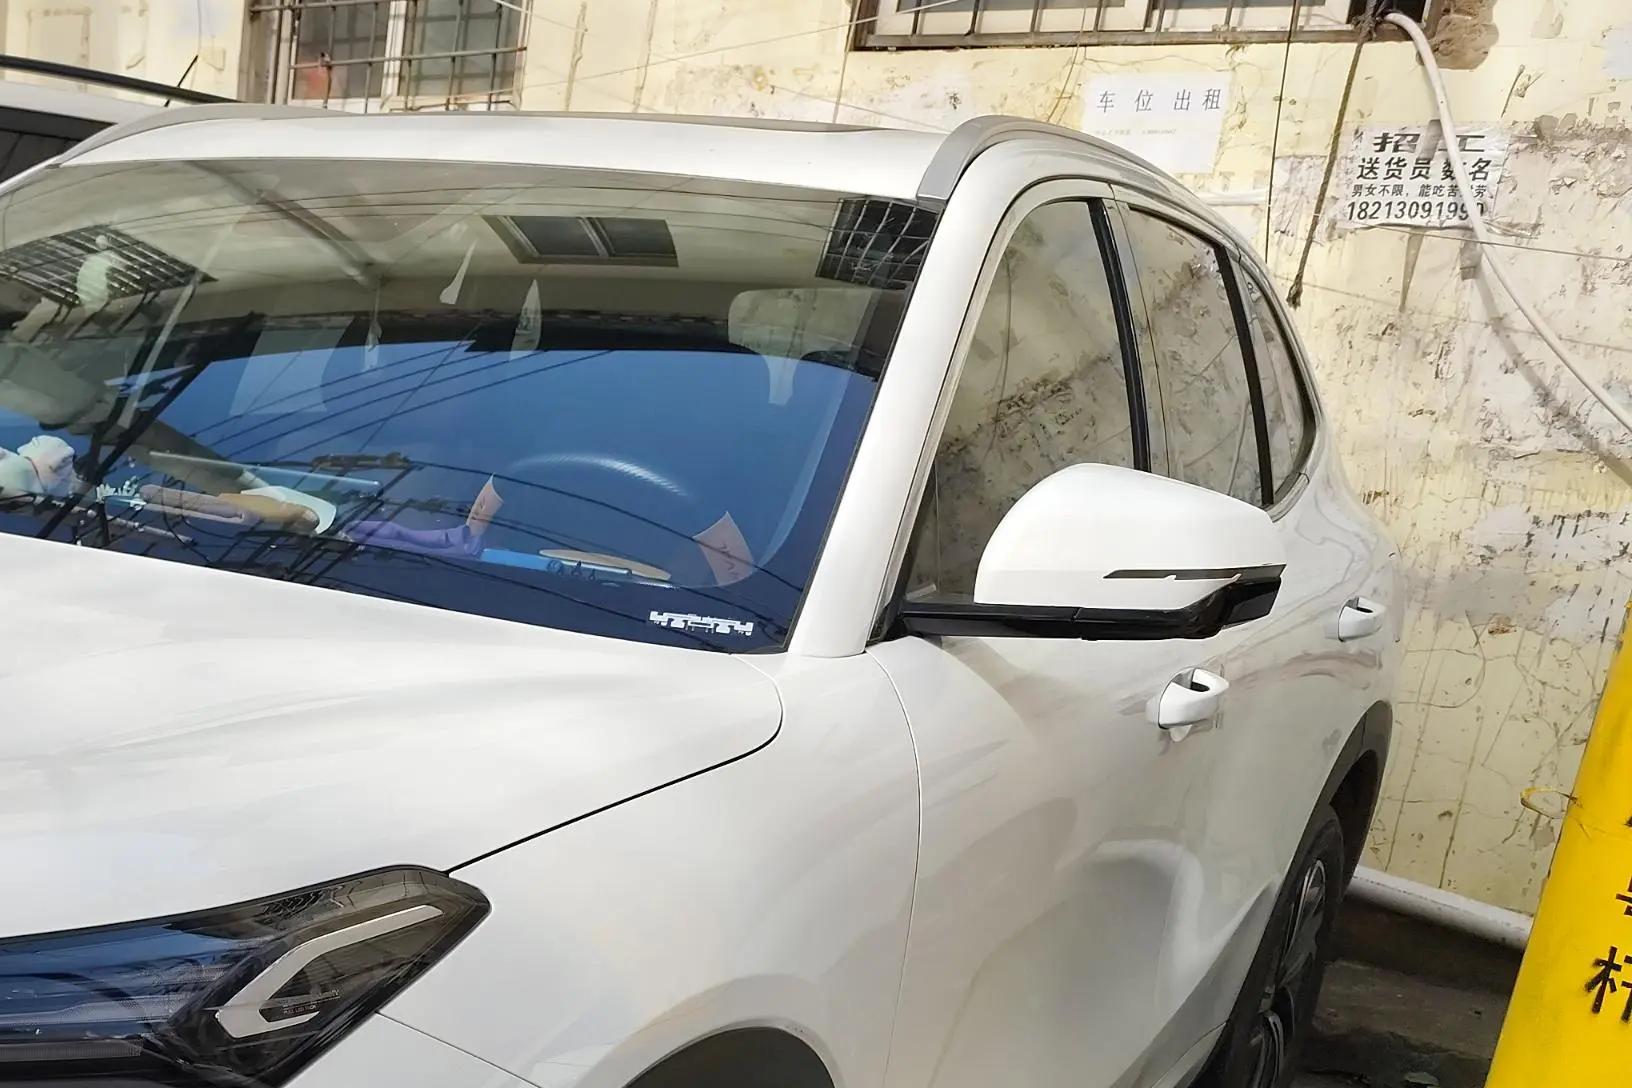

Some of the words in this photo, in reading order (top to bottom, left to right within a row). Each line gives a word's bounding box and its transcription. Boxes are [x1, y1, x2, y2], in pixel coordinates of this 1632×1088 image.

[1096, 88, 1222, 114] 车位出租
[1373, 132, 1486, 153] 招工
[1351, 183, 1488, 198] 男女不限，能吃苦劳
